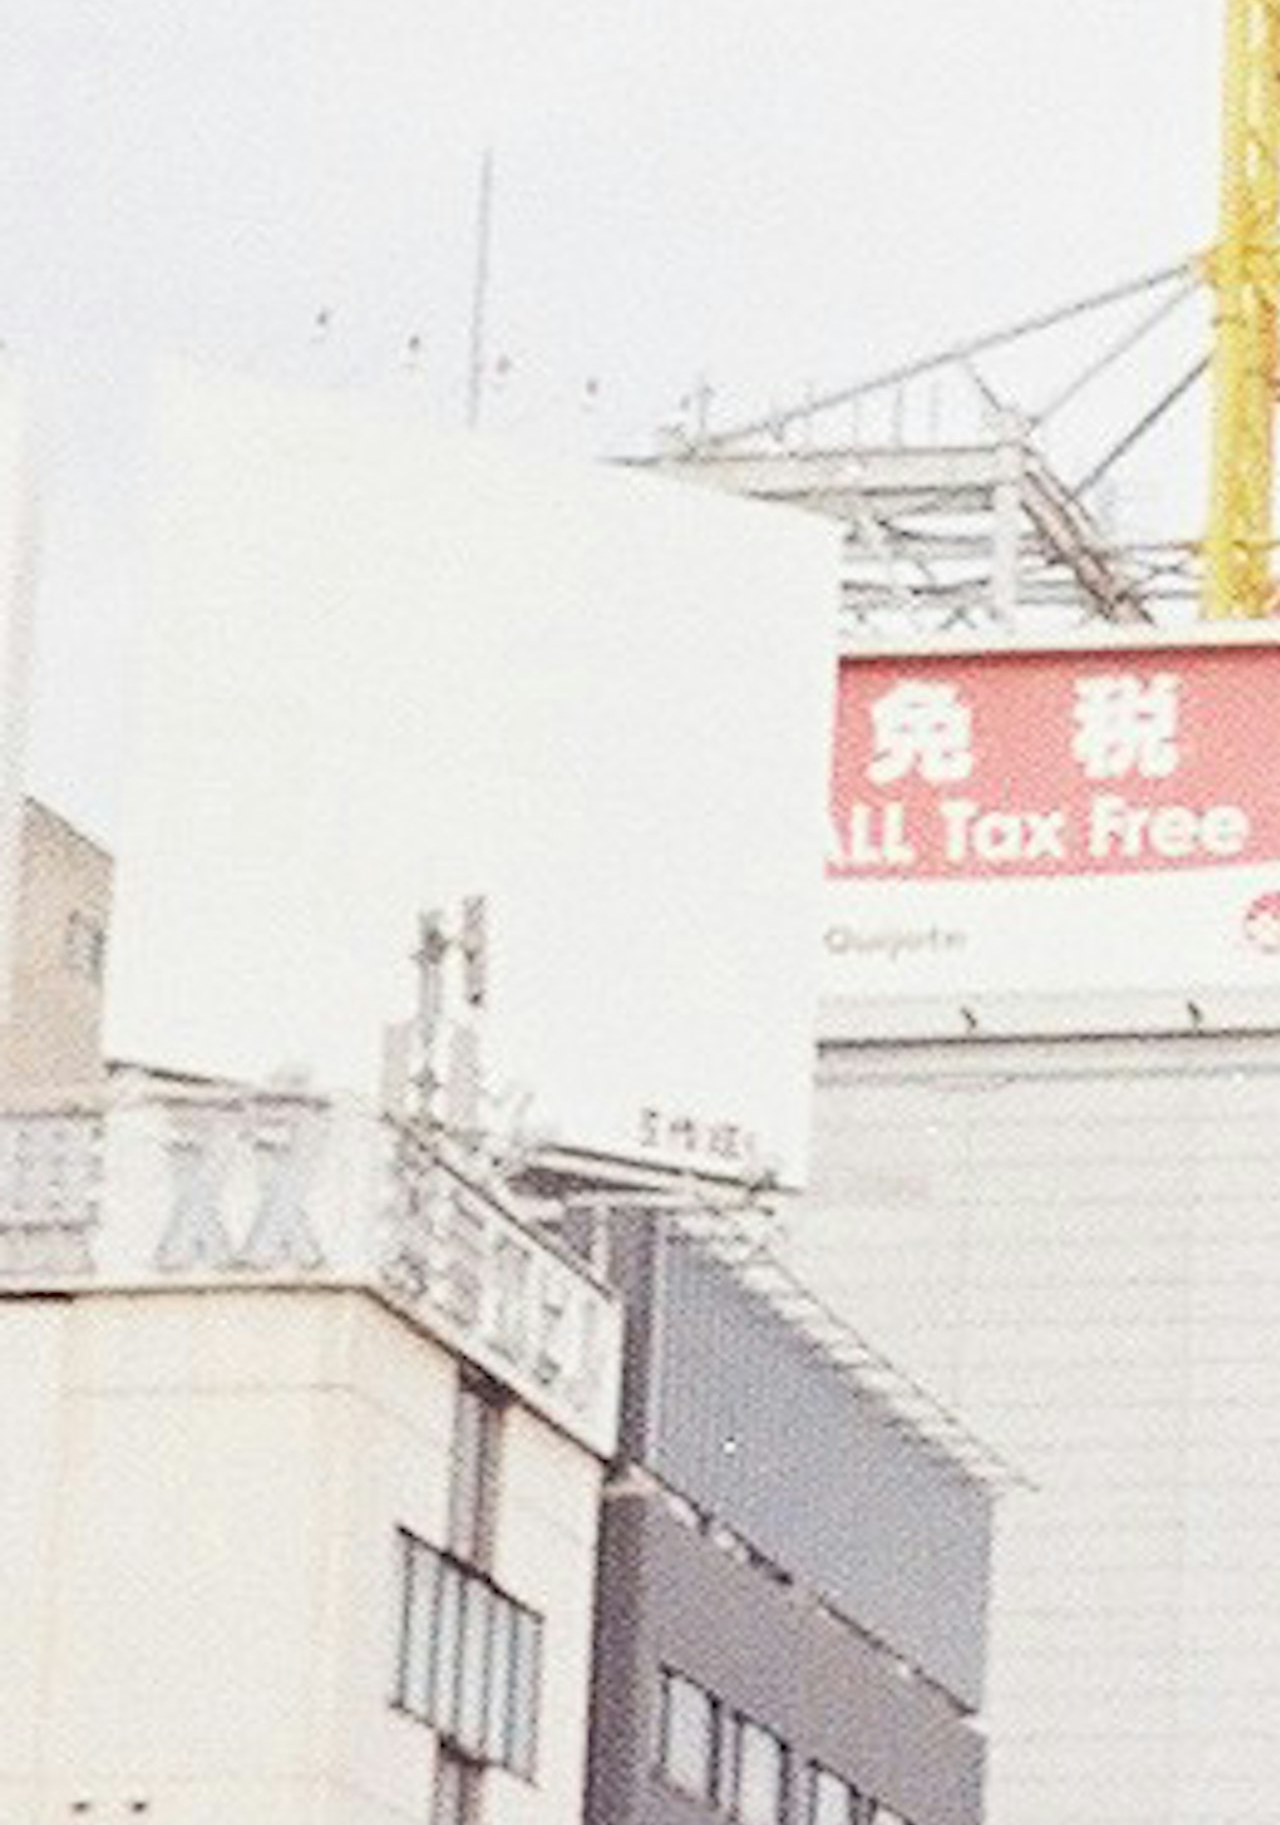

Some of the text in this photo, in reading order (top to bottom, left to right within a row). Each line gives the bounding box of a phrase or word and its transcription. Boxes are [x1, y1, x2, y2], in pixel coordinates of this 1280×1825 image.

[828, 791, 1250, 866] LL Tax Free
